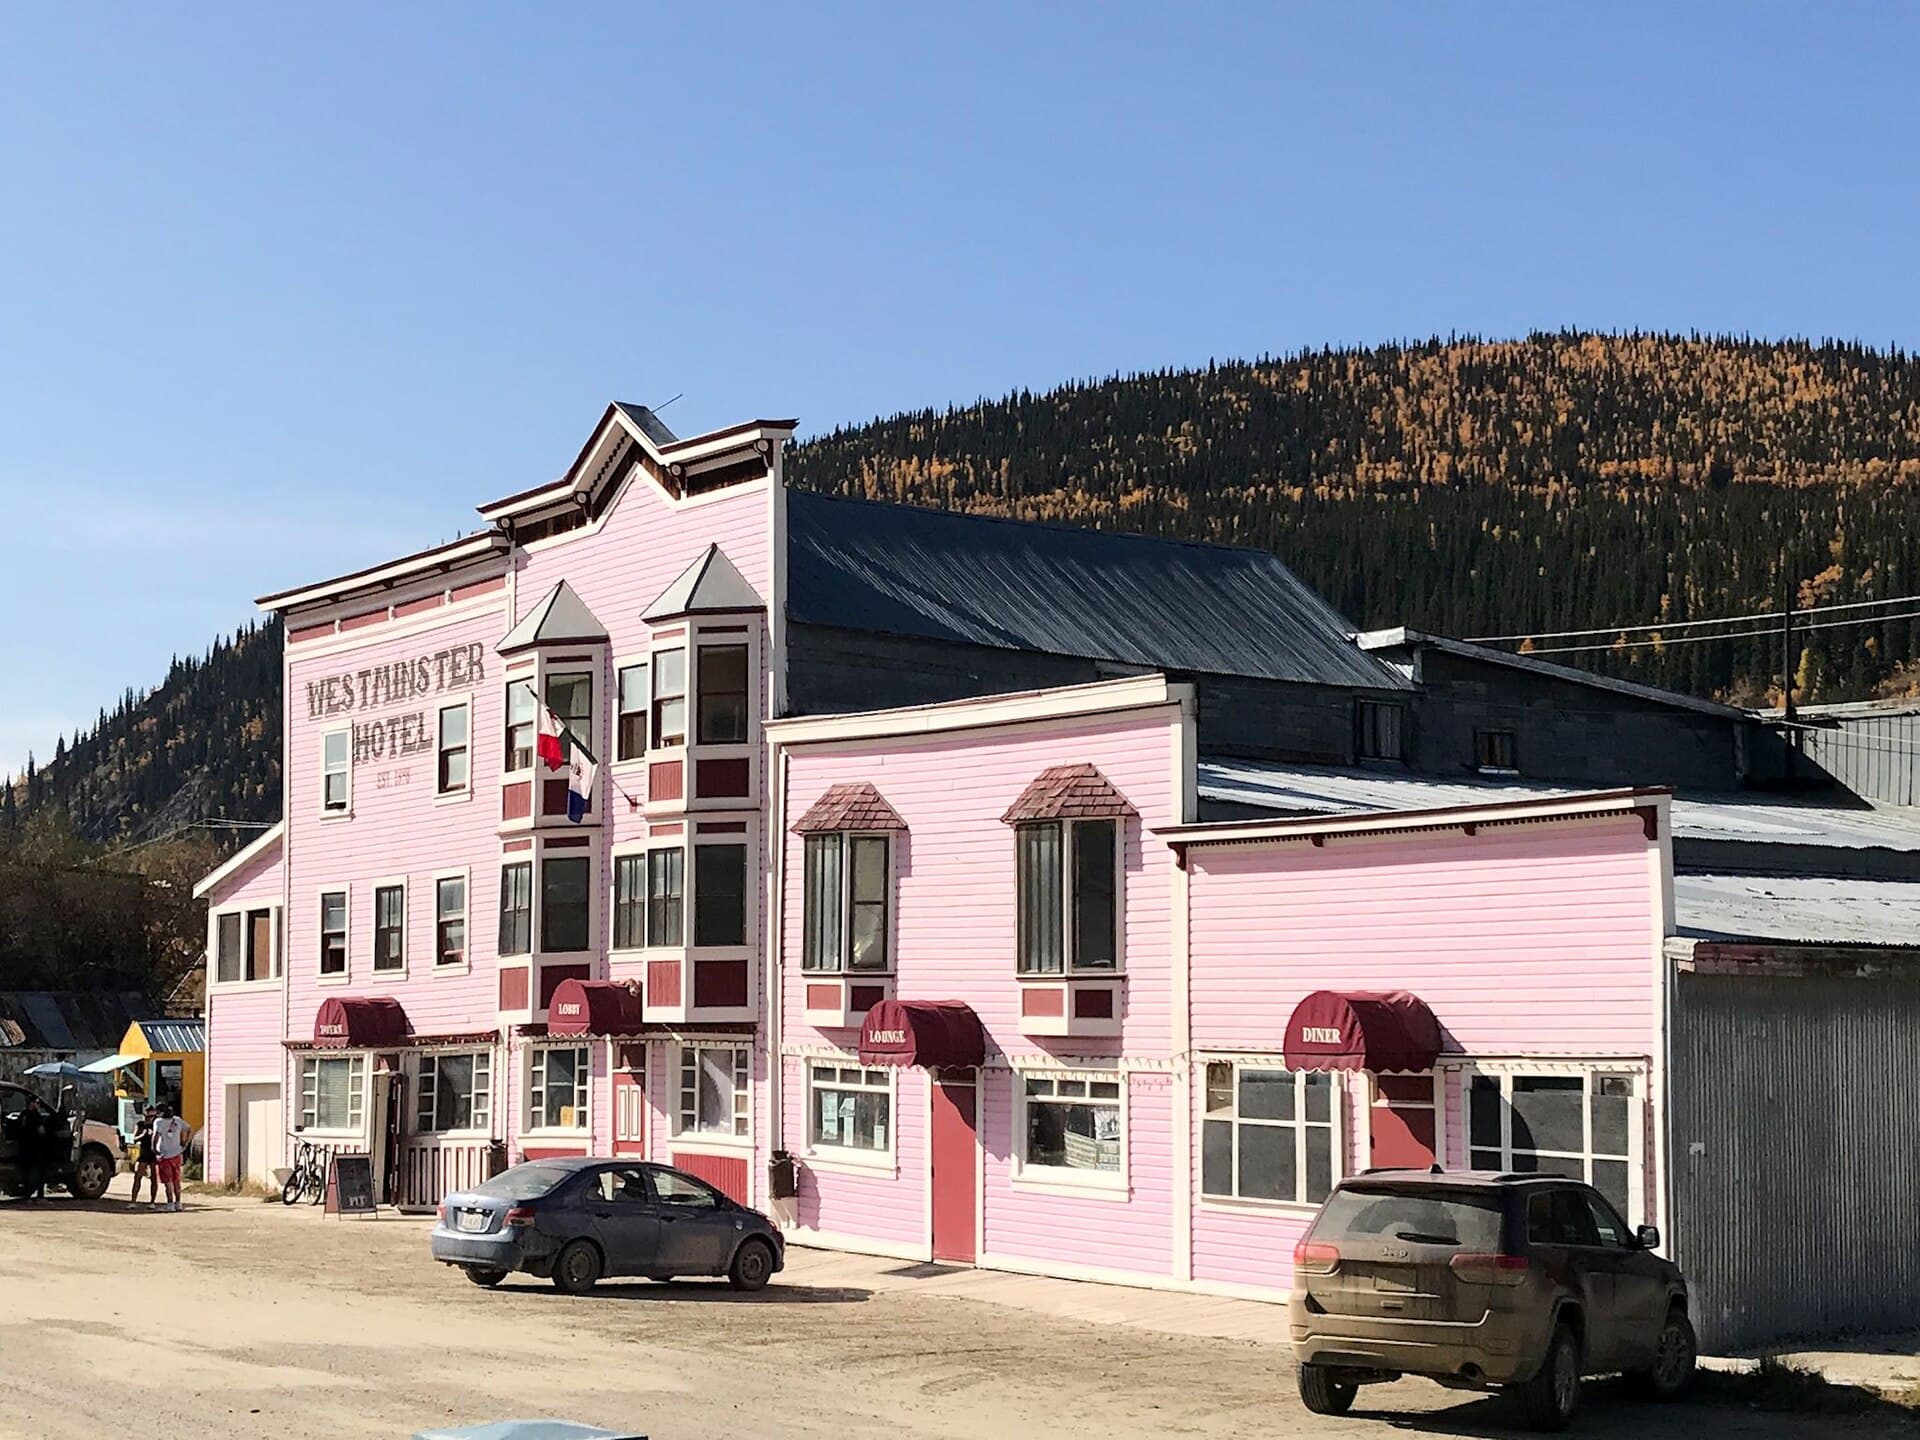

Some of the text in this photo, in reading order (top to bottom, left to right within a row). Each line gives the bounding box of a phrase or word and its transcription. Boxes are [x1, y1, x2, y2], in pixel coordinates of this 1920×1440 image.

[308, 643, 485, 719] WESTMINSTER
[354, 712, 433, 766] HOTEL
[558, 1003, 581, 1015] LOBBY
[868, 1029, 906, 1043] LOUNGE
[1302, 1027, 1342, 1044] DINER
